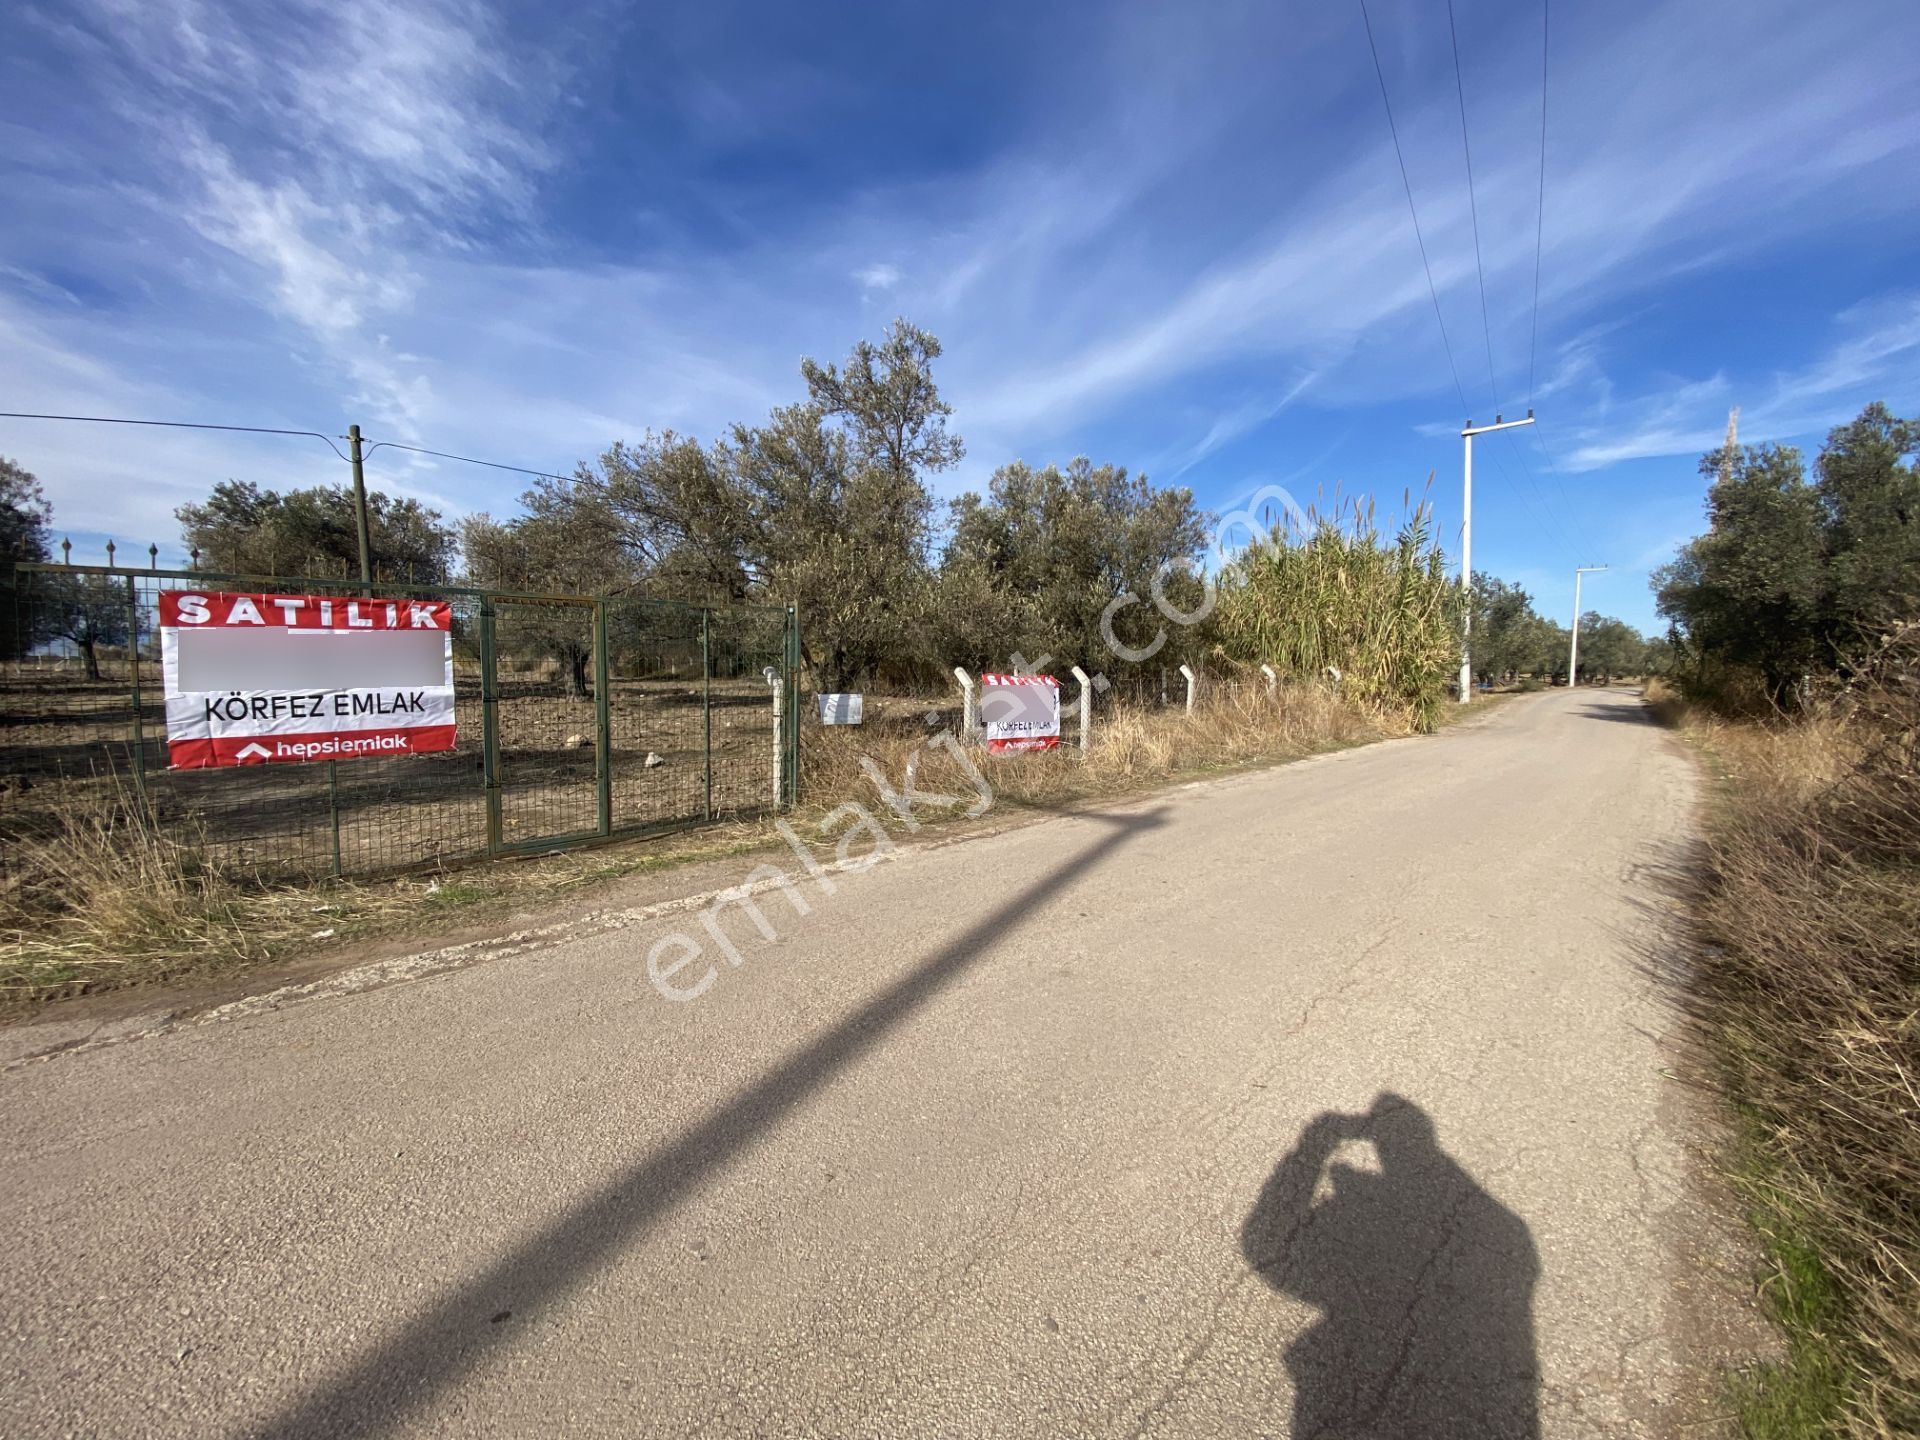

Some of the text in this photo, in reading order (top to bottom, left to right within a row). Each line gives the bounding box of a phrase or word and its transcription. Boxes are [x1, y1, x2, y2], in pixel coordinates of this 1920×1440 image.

[177, 595, 438, 628] SATILIK
[205, 691, 425, 721] KÖRFEZ EMLAK
[277, 734, 407, 757] hepsiemlak
